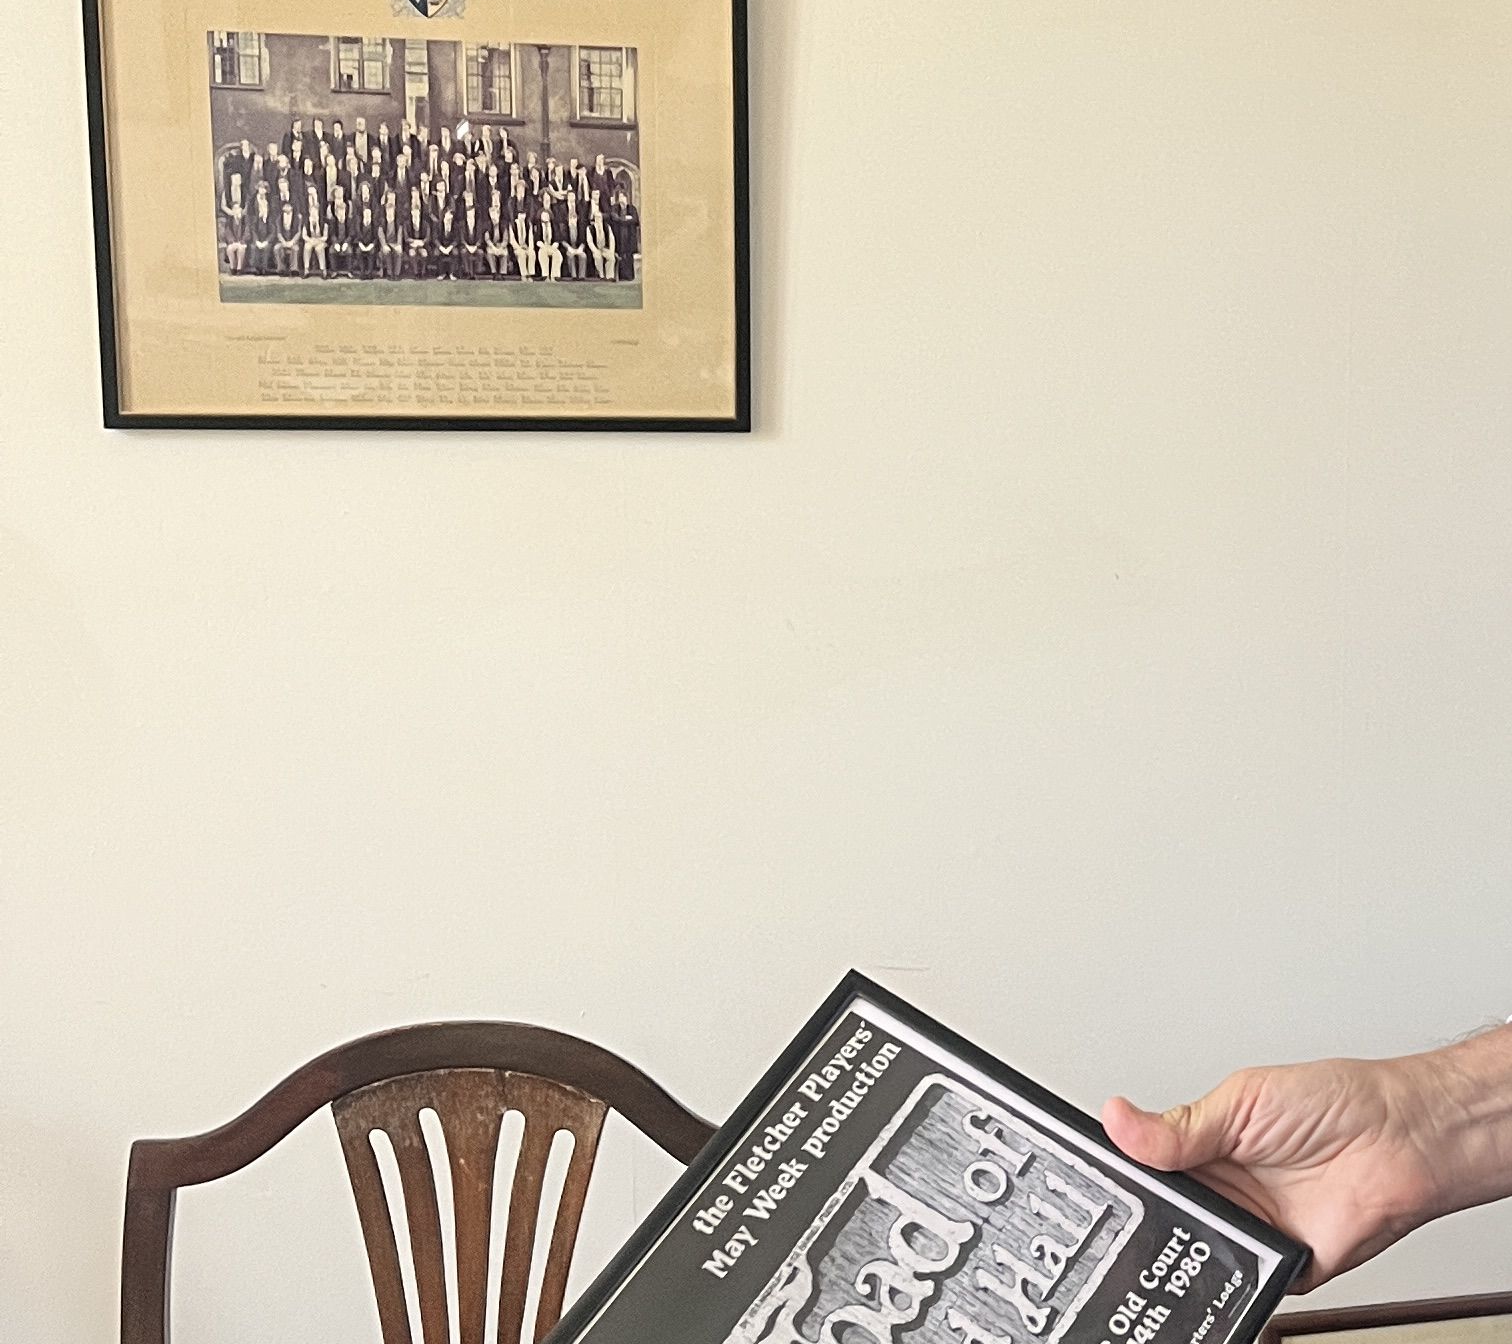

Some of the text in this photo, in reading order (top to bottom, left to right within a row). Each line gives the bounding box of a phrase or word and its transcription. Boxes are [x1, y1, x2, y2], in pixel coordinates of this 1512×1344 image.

[692, 1020, 873, 1235] the Fletcher Players'
[702, 1041, 902, 1278] May Week production
[962, 1107, 1036, 1205] of
[975, 1169, 1114, 1335] Hall
[1108, 1291, 1147, 1337] Old
[1138, 1226, 1192, 1291] Court
[1164, 1240, 1212, 1299] 1980
[1212, 1269, 1245, 1309] Lodge
